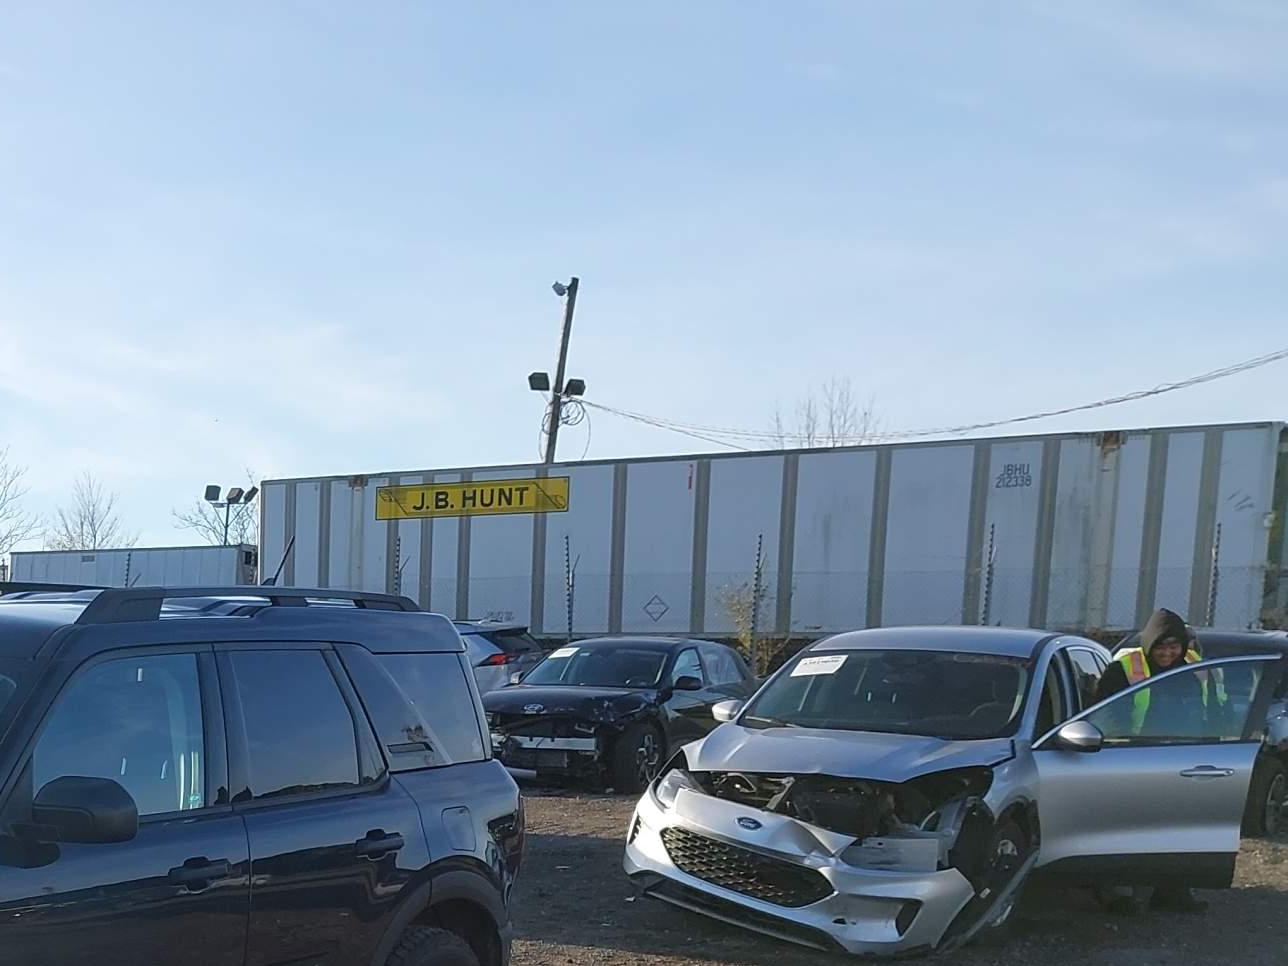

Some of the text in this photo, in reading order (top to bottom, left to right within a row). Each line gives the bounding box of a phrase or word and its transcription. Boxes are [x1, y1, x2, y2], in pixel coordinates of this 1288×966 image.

[995, 475, 1032, 488] 212338
[412, 487, 529, 511] J.B. HUNT
